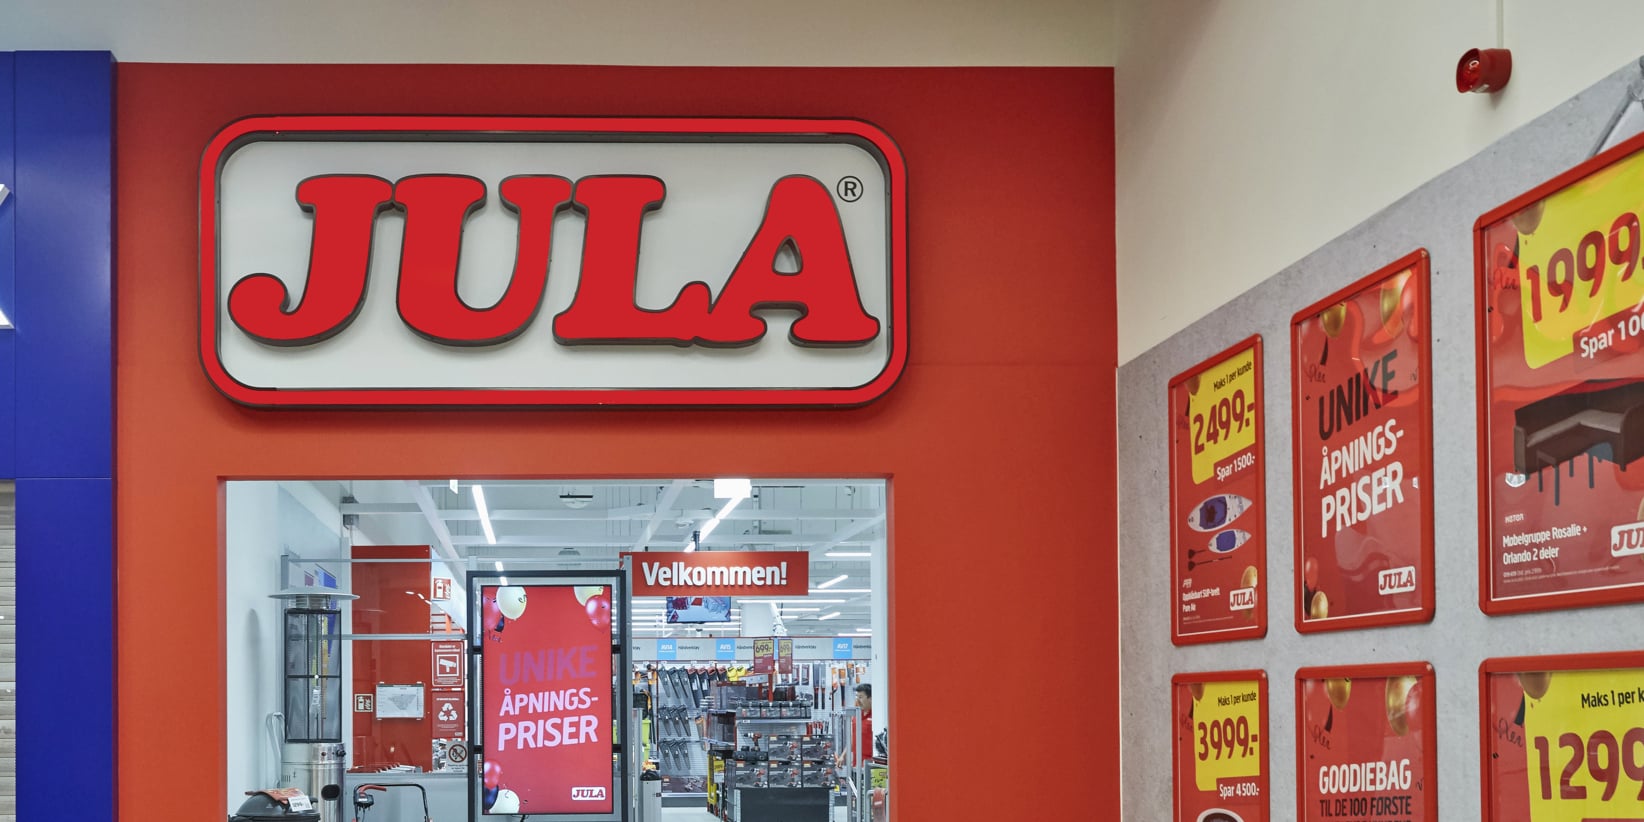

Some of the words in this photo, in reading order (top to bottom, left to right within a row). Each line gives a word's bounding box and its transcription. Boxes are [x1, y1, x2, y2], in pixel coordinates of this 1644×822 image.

[227, 174, 881, 347] JULA
[1526, 212, 1642, 324] 1999
[1580, 328, 1615, 359] Spar
[1618, 312, 1644, 341] 10
[1213, 379, 1226, 392] Maks
[1228, 372, 1237, 384] per
[1237, 361, 1252, 377] kunde
[1318, 349, 1399, 441] UNIKE
[1319, 418, 1405, 489] ÅPNINGS-
[1216, 463, 1233, 482] Spar
[1321, 461, 1404, 538] PRISER
[1551, 523, 1582, 540] Rosalie
[1613, 527, 1644, 551] JU
[1503, 550, 1532, 565] Orlando
[1532, 548, 1538, 560] 2
[1539, 546, 1560, 559] deler
[642, 561, 787, 586] Velkommen!
[1380, 570, 1414, 590] JULA
[1231, 591, 1254, 607] JULA
[500, 645, 598, 685] UNIKE
[499, 687, 598, 717] ÅPNINGS-
[1218, 696, 1230, 707] Maks
[1233, 694, 1241, 705] per
[1241, 691, 1256, 703] kunde
[1581, 692, 1609, 708] Maks
[1611, 690, 1615, 706] 1
[1618, 690, 1635, 707] per
[498, 715, 598, 751] PRISER
[1319, 758, 1412, 795] GOODIEBAG
[572, 789, 605, 799] JULA
[1219, 783, 1234, 800] Spar
[1320, 799, 1332, 817] TIL
[1335, 799, 1347, 816] DE
[1349, 797, 1367, 816] 100
[1370, 795, 1412, 816] FØRSTE
